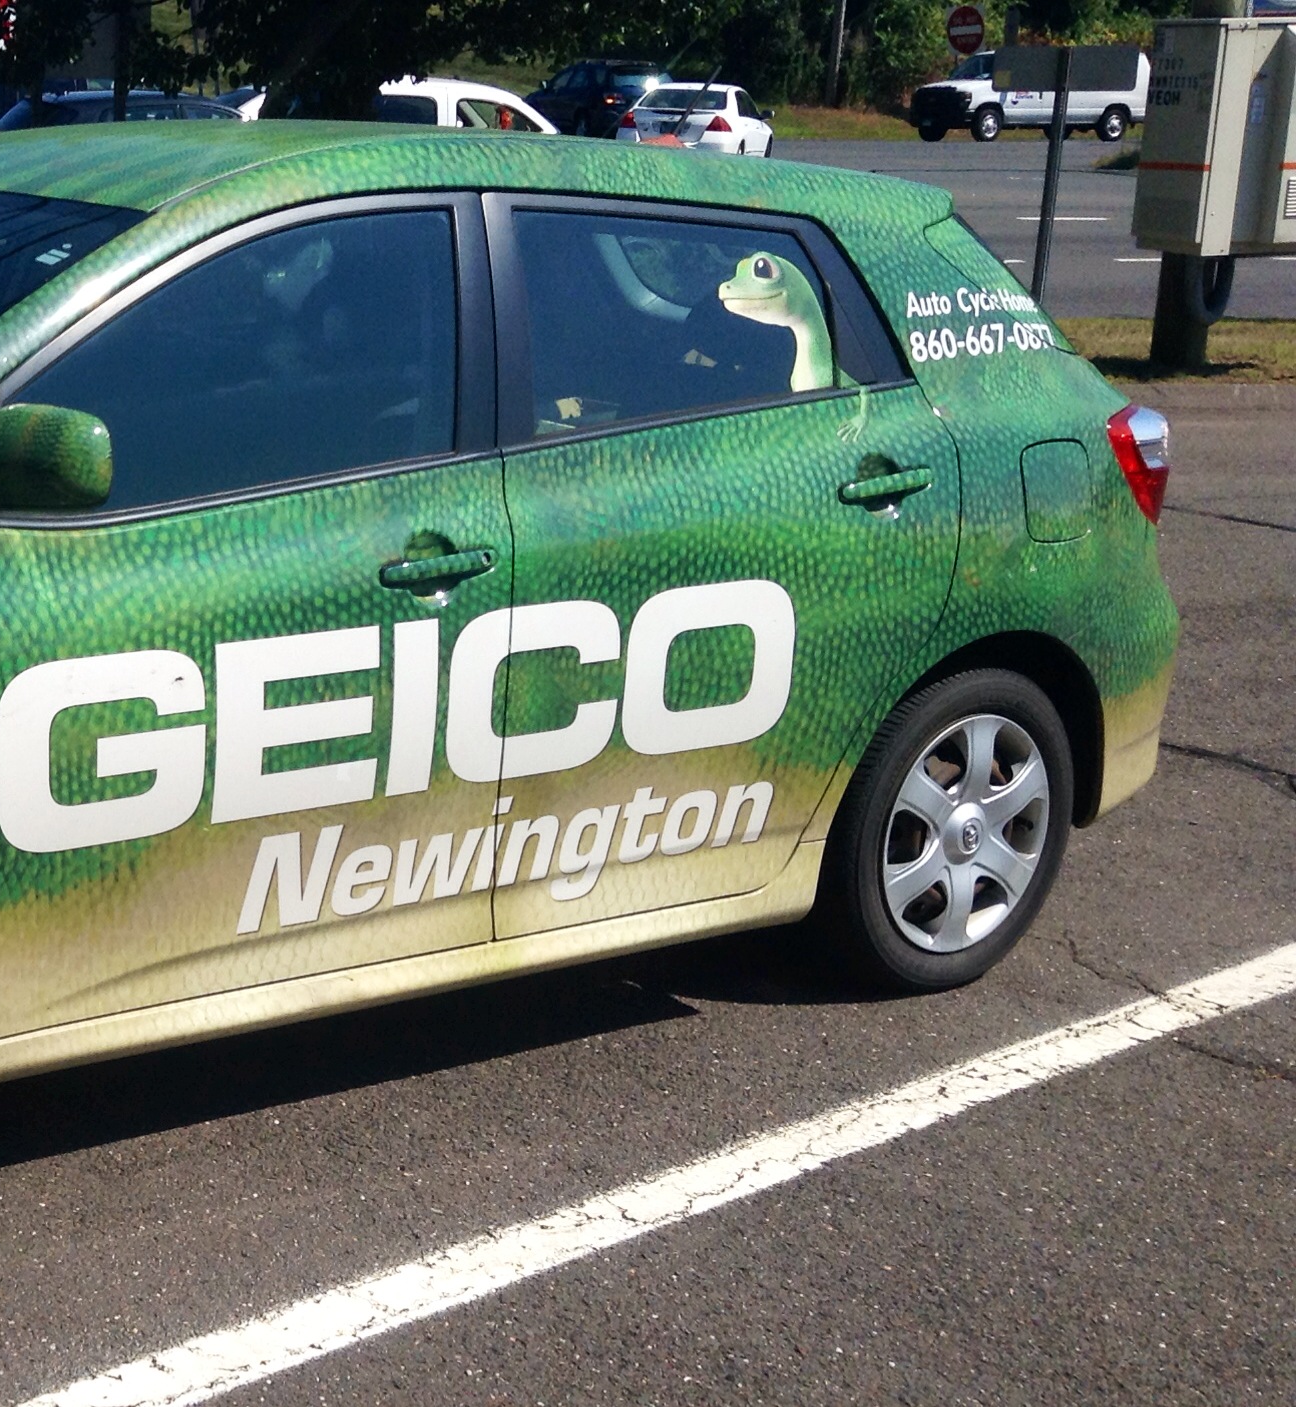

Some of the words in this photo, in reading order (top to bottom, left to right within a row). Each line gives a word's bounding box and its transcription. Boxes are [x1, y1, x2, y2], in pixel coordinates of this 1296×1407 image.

[907, 291, 952, 318] Auto
[997, 287, 1038, 314] Home
[909, 322, 1055, 362] 860-667-0877
[236, 780, 776, 936] Newington
